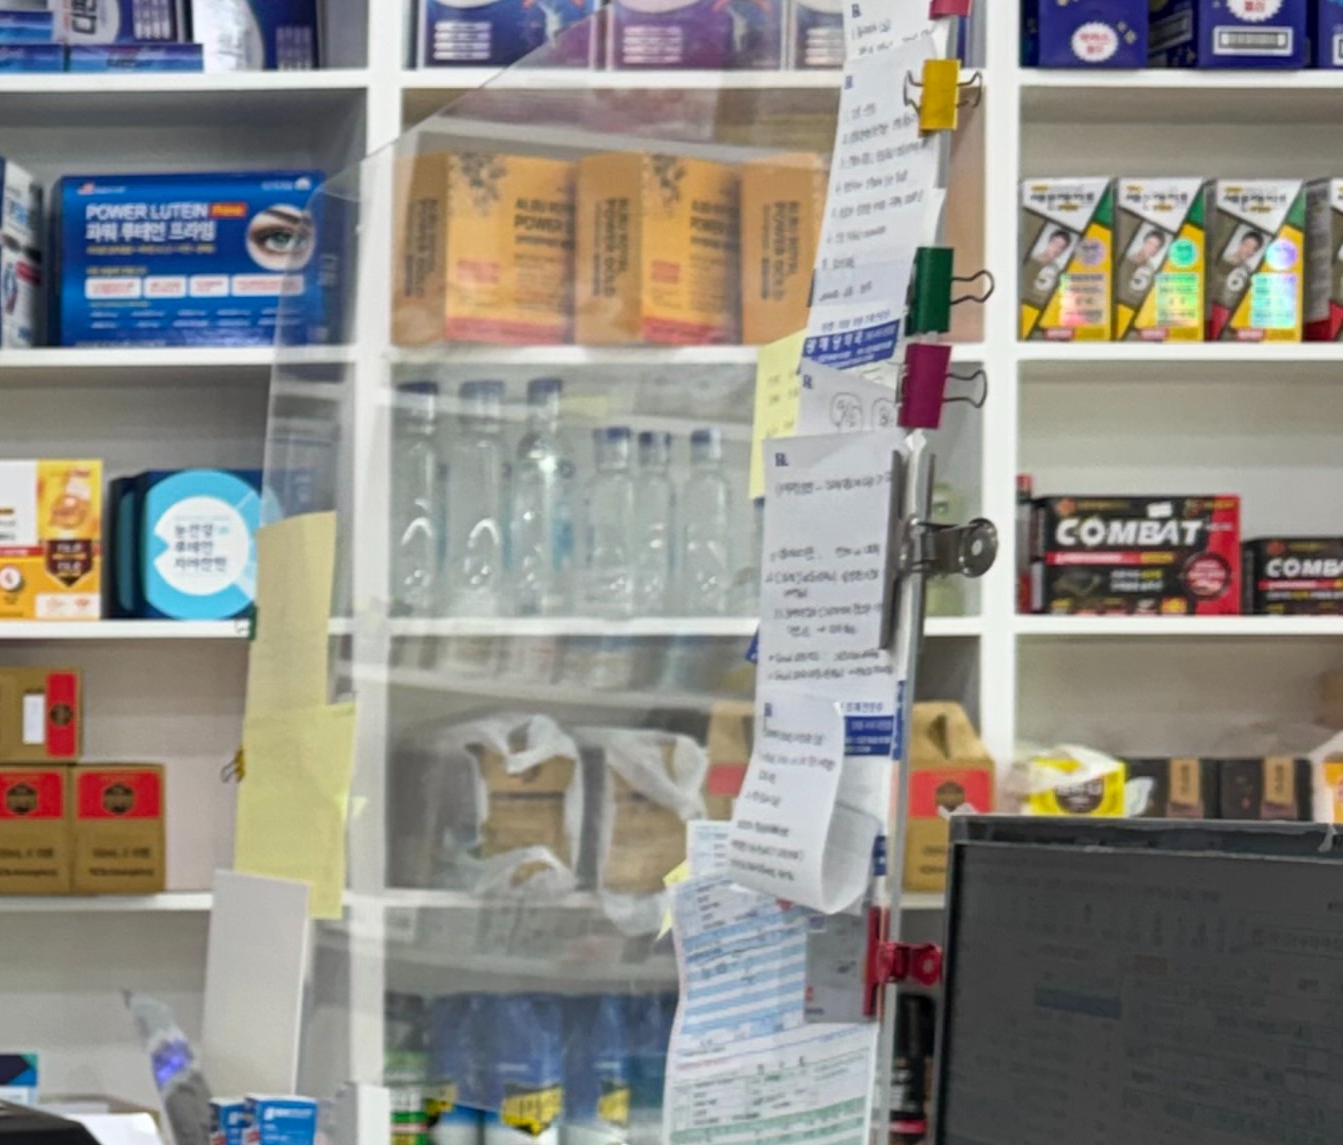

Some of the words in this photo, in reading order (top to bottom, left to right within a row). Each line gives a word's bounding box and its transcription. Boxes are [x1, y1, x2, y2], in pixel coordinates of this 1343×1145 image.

[85, 203, 148, 221] POWER
[150, 202, 210, 220] LUTEIN
[85, 222, 118, 242] 파워
[121, 222, 167, 242] 루테인
[169, 221, 217, 242] 프라임
[1055, 516, 1202, 548] COMBAT
[175, 541, 213, 556] 루테인
